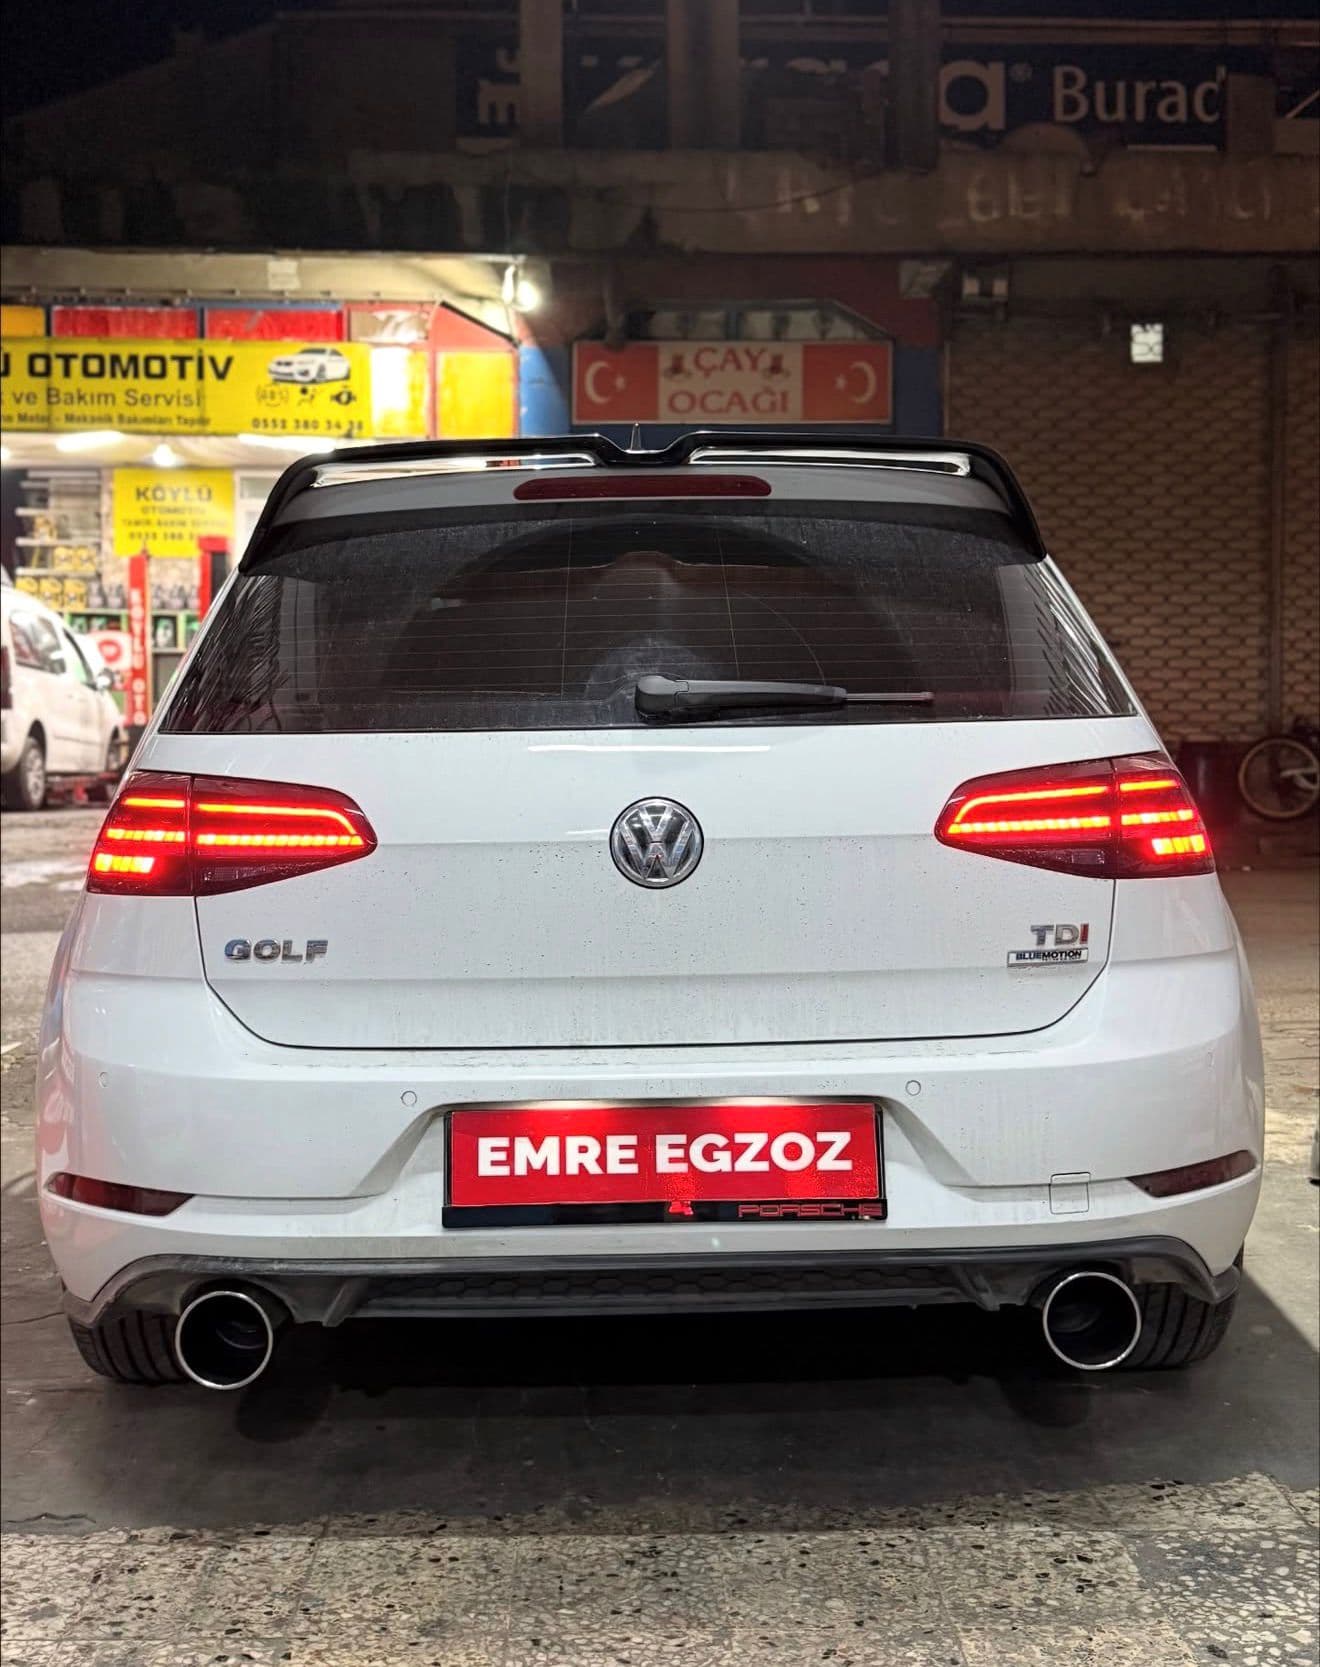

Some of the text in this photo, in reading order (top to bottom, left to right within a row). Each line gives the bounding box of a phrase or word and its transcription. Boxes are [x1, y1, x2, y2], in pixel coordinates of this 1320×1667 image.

[28, 349, 234, 381] OTOMOTİV
[693, 346, 768, 379] ÇAY
[12, 387, 202, 407] ve Bakım Servisi
[667, 384, 789, 414] OCAĞI
[1030, 923, 1089, 946] TDI
[223, 938, 329, 962] GOLF
[1015, 949, 1083, 962] BLUEMOTION
[477, 1130, 853, 1178] EMRE EGZOZ
[737, 1202, 884, 1218] PORSCHE
